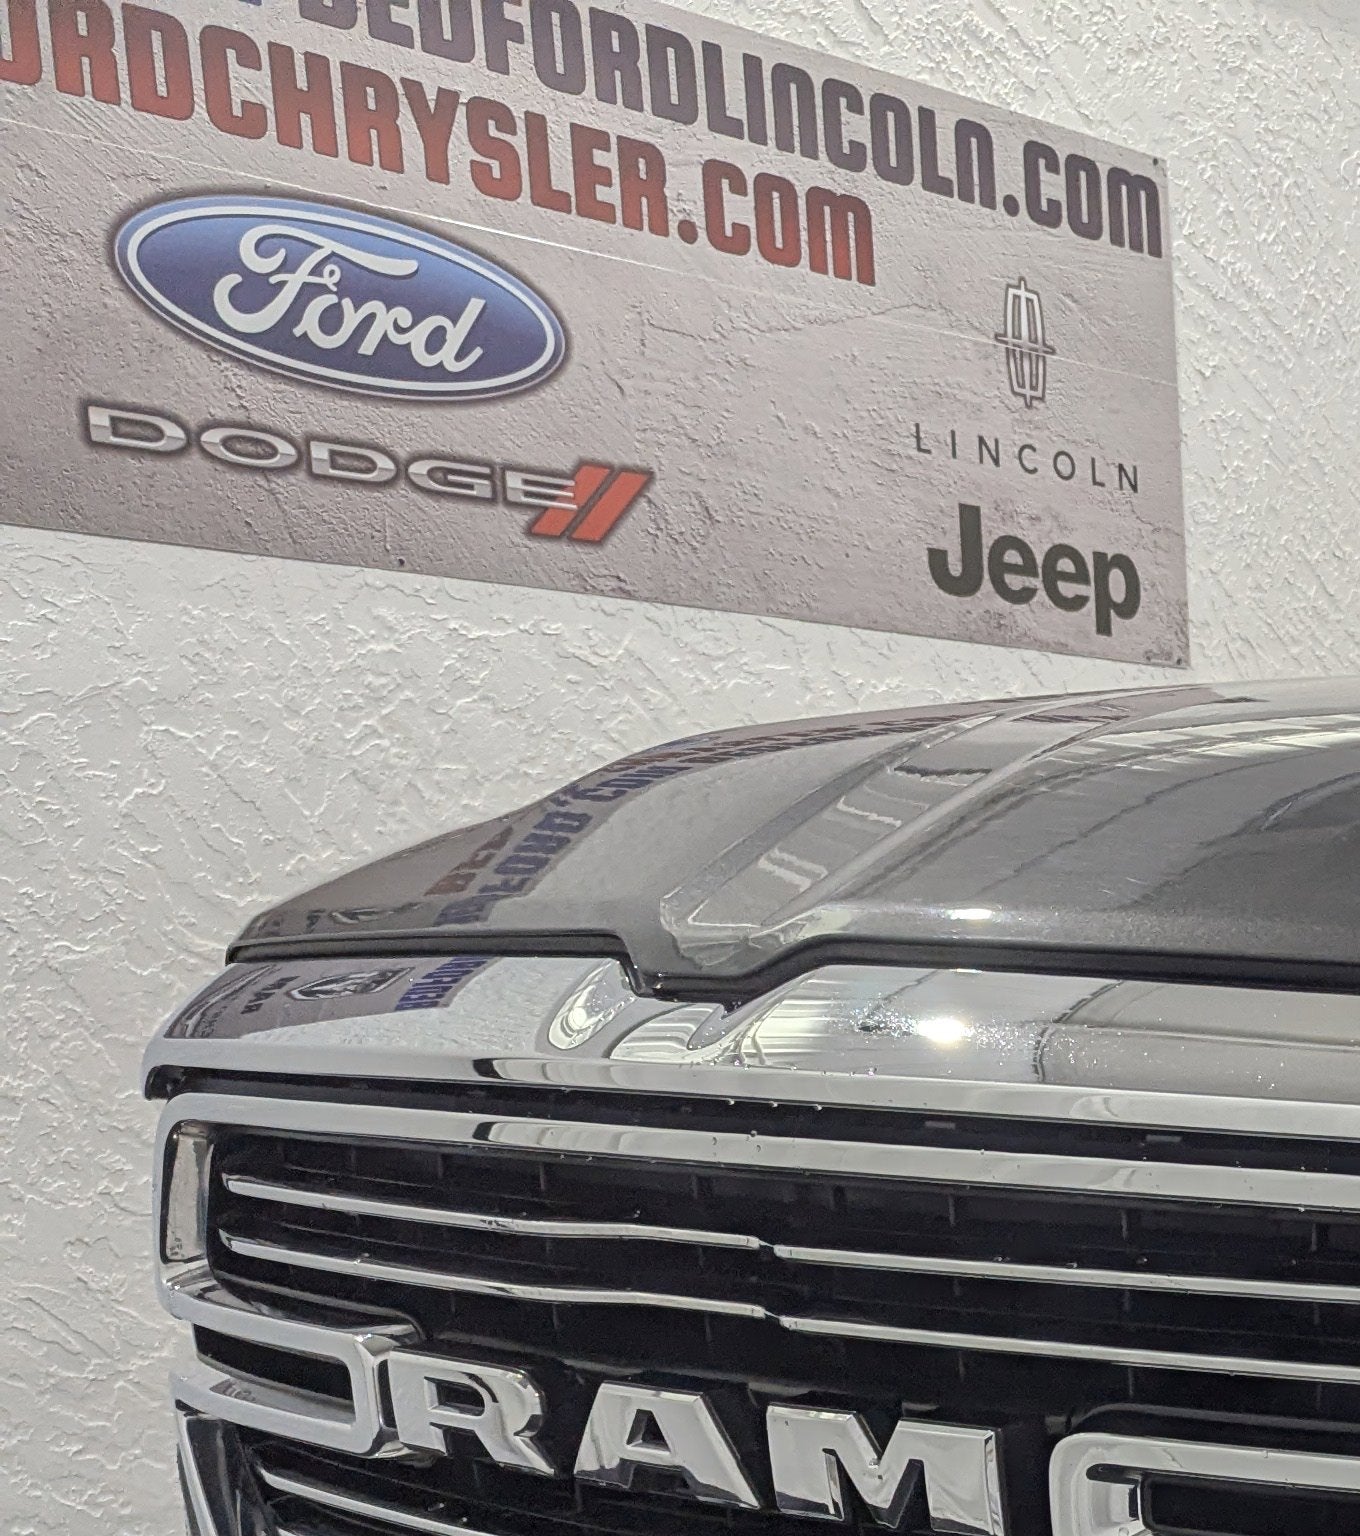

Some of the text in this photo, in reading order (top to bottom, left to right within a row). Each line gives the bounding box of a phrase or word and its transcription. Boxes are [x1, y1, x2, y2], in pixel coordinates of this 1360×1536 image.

[300, 0, 1163, 258] DFORDLINCOLN.COM
[213, 223, 487, 373] Ford
[87, 404, 578, 513] DODGE
[914, 421, 1140, 494] LINCOLN
[926, 503, 1141, 637] Jeep
